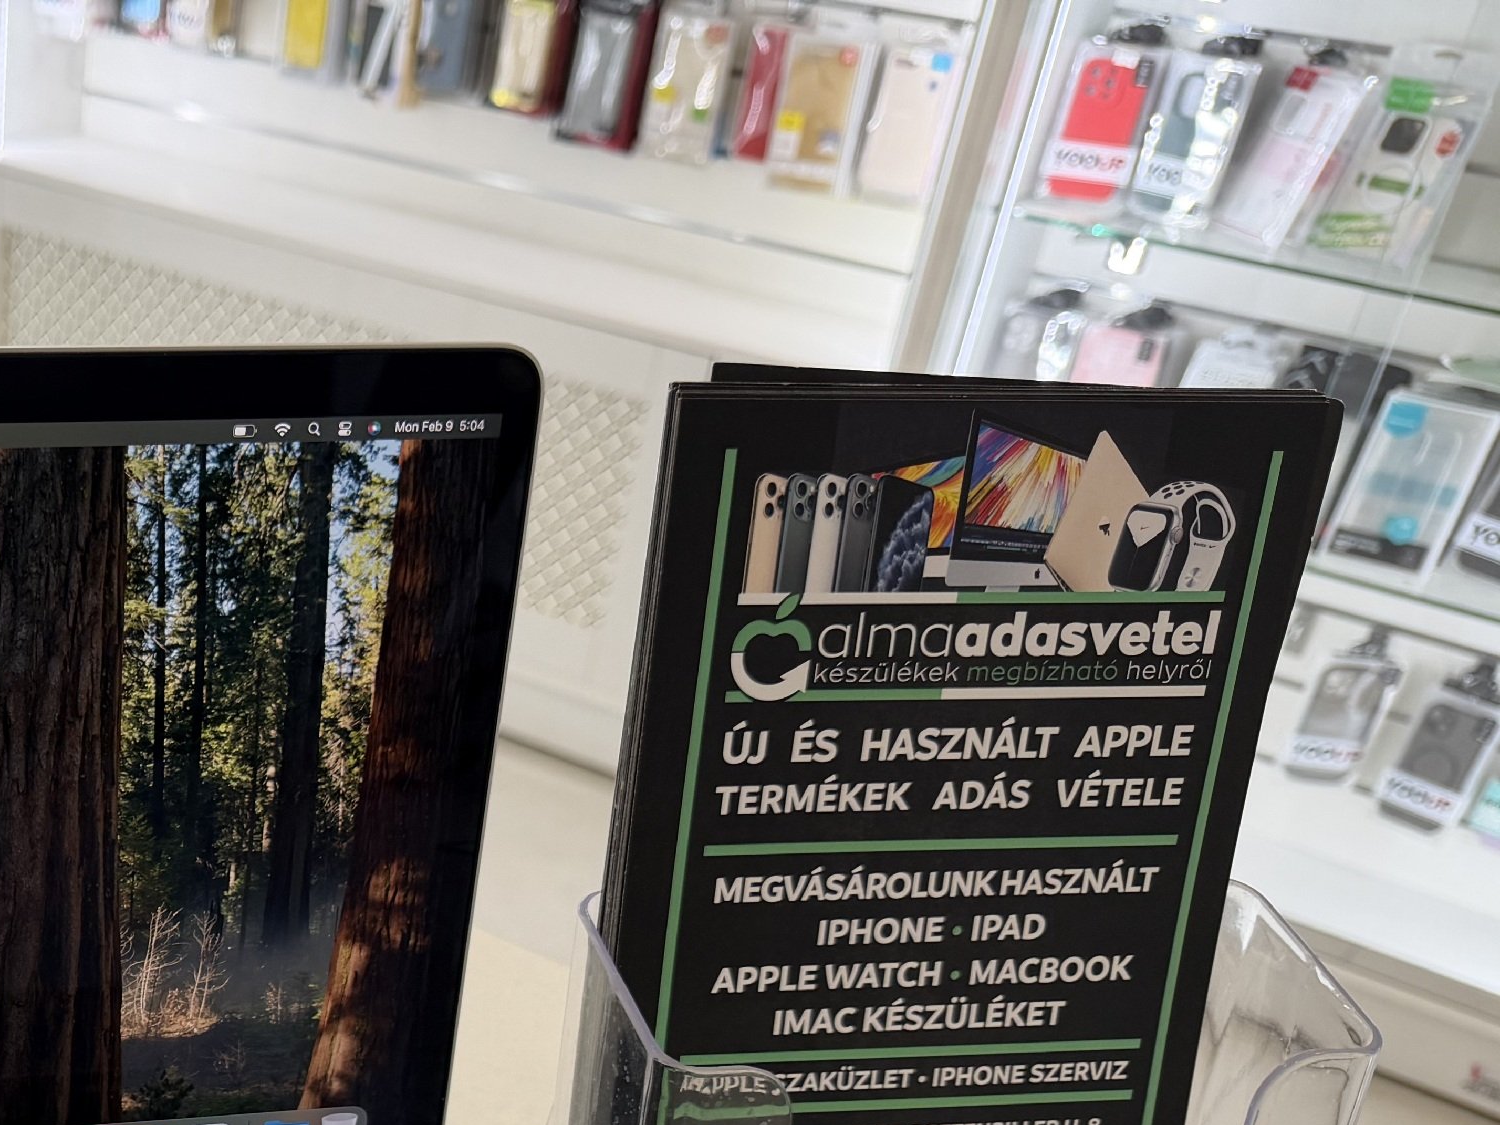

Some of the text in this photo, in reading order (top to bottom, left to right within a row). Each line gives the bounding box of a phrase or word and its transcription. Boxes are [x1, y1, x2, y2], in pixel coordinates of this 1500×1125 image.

[394, 419, 485, 433] Mon Feb 9 5:04
[816, 610, 1222, 660] almaadasvetel
[814, 658, 1212, 685] készülékek megbízható helyről
[722, 716, 1195, 765] ÚJ ÉS HASZNÁLT APPLE
[715, 770, 1184, 816] TERMÉKEK ADÁS VÉTELE
[713, 859, 1160, 904] MEGVÁSÁROLUNK HASZNÁLT
[816, 914, 1046, 946] IPHONE IPAD
[711, 954, 1134, 993] APPLE WATCH MACBOOK
[772, 998, 1067, 1036] IMAC KÉSZÜLÉKET
[932, 1062, 1026, 1087] IPHONE
[1030, 1060, 1129, 1084] SZERVIZ
